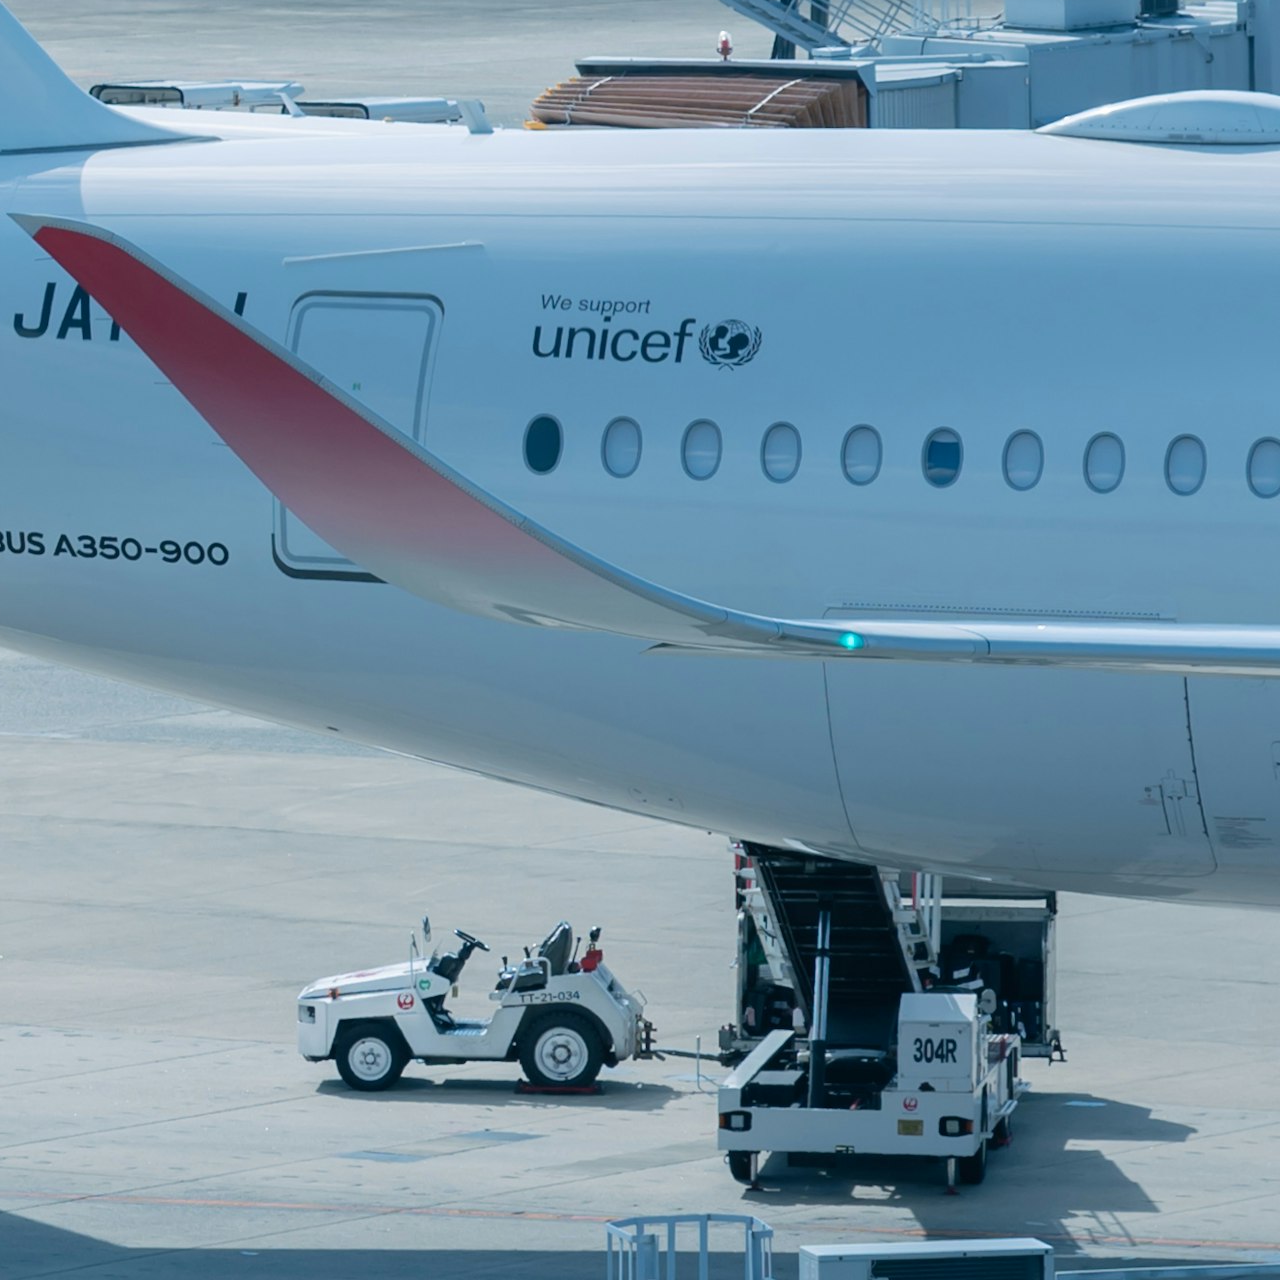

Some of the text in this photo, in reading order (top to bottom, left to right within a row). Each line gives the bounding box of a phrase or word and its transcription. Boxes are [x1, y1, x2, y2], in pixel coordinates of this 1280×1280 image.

[541, 294, 651, 316] We support
[532, 317, 696, 363] unicef
[53, 534, 229, 566] A350-900
[521, 990, 580, 1003] TT-21-034
[913, 1038, 957, 1063] 304R
